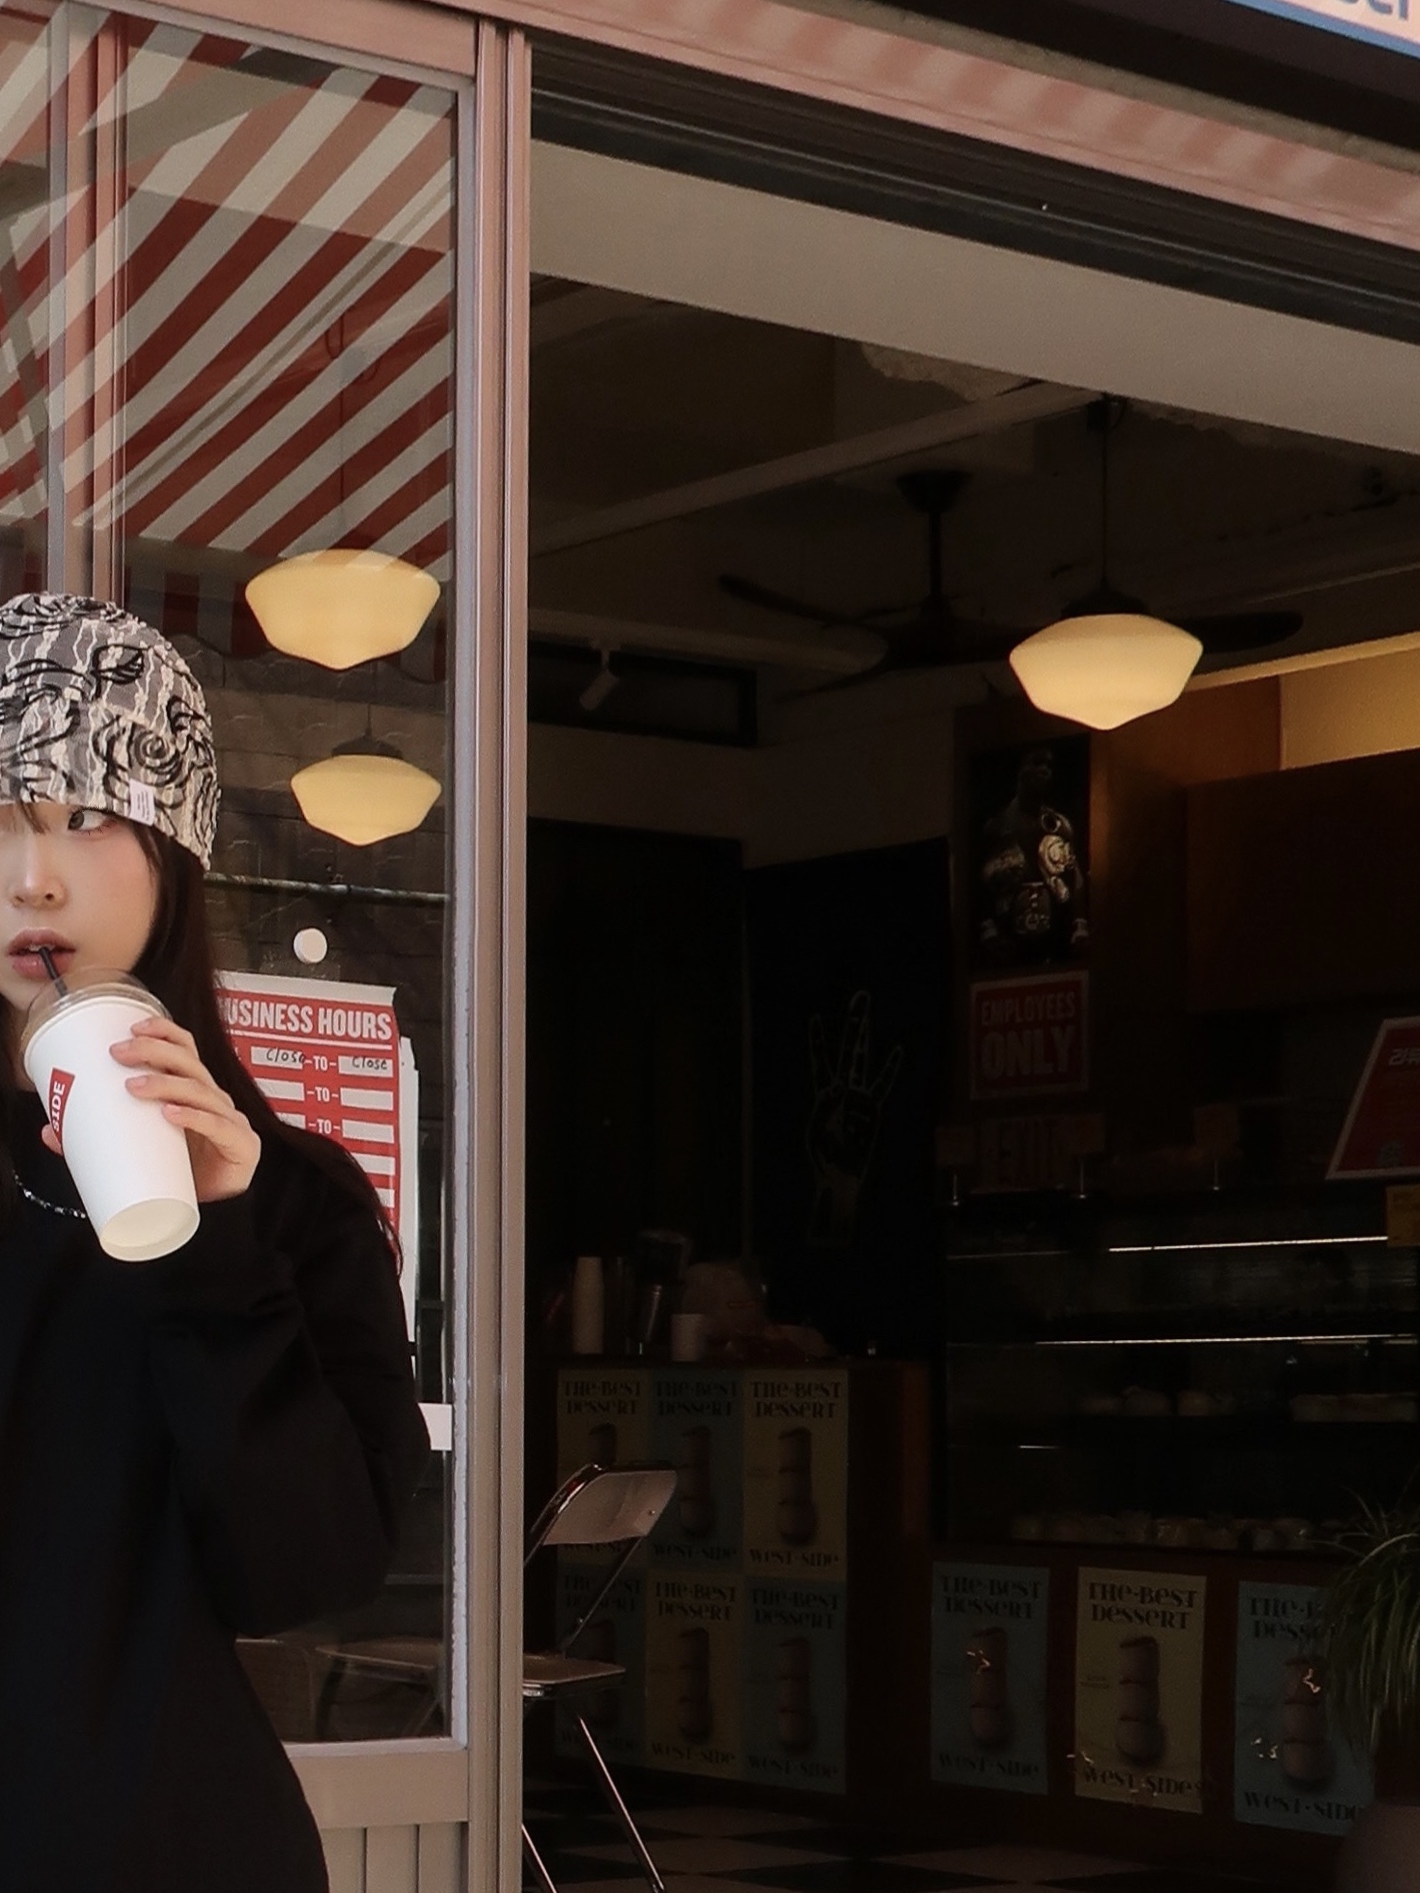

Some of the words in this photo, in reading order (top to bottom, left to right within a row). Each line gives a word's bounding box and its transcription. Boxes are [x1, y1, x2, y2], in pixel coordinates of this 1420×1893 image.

[318, 1007, 393, 1041] HOURS
[981, 991, 1076, 1026] EMPLOYEES
[981, 1024, 1077, 1079] ONLY
[51, 1081, 66, 1133] SIDE
